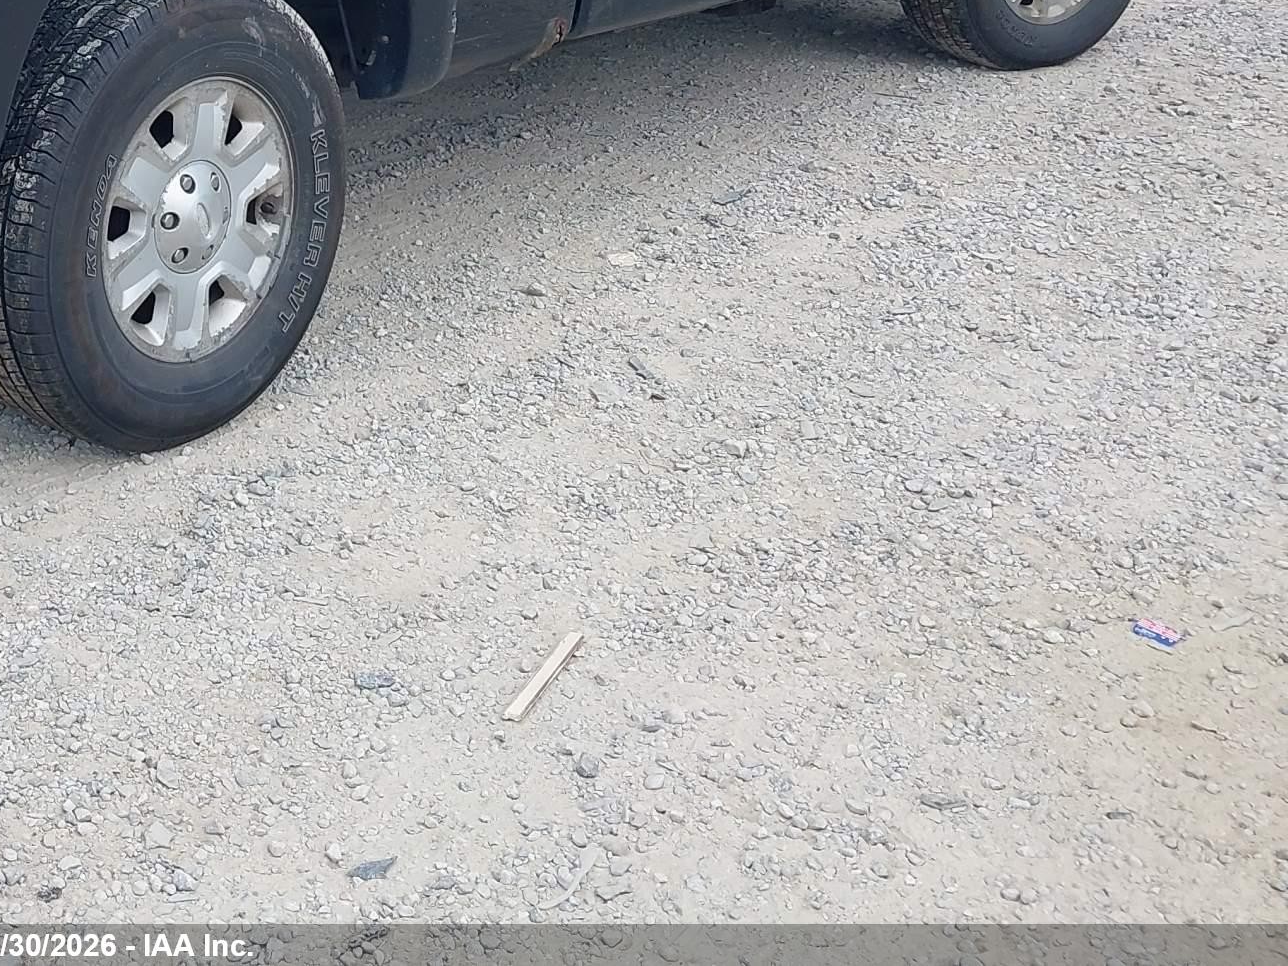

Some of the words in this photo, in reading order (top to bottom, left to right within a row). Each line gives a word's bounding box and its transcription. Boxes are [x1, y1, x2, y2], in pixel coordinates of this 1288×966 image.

[85, 153, 118, 278] KENDA
[304, 129, 331, 268] KLEVER
[278, 272, 313, 334] H/T
